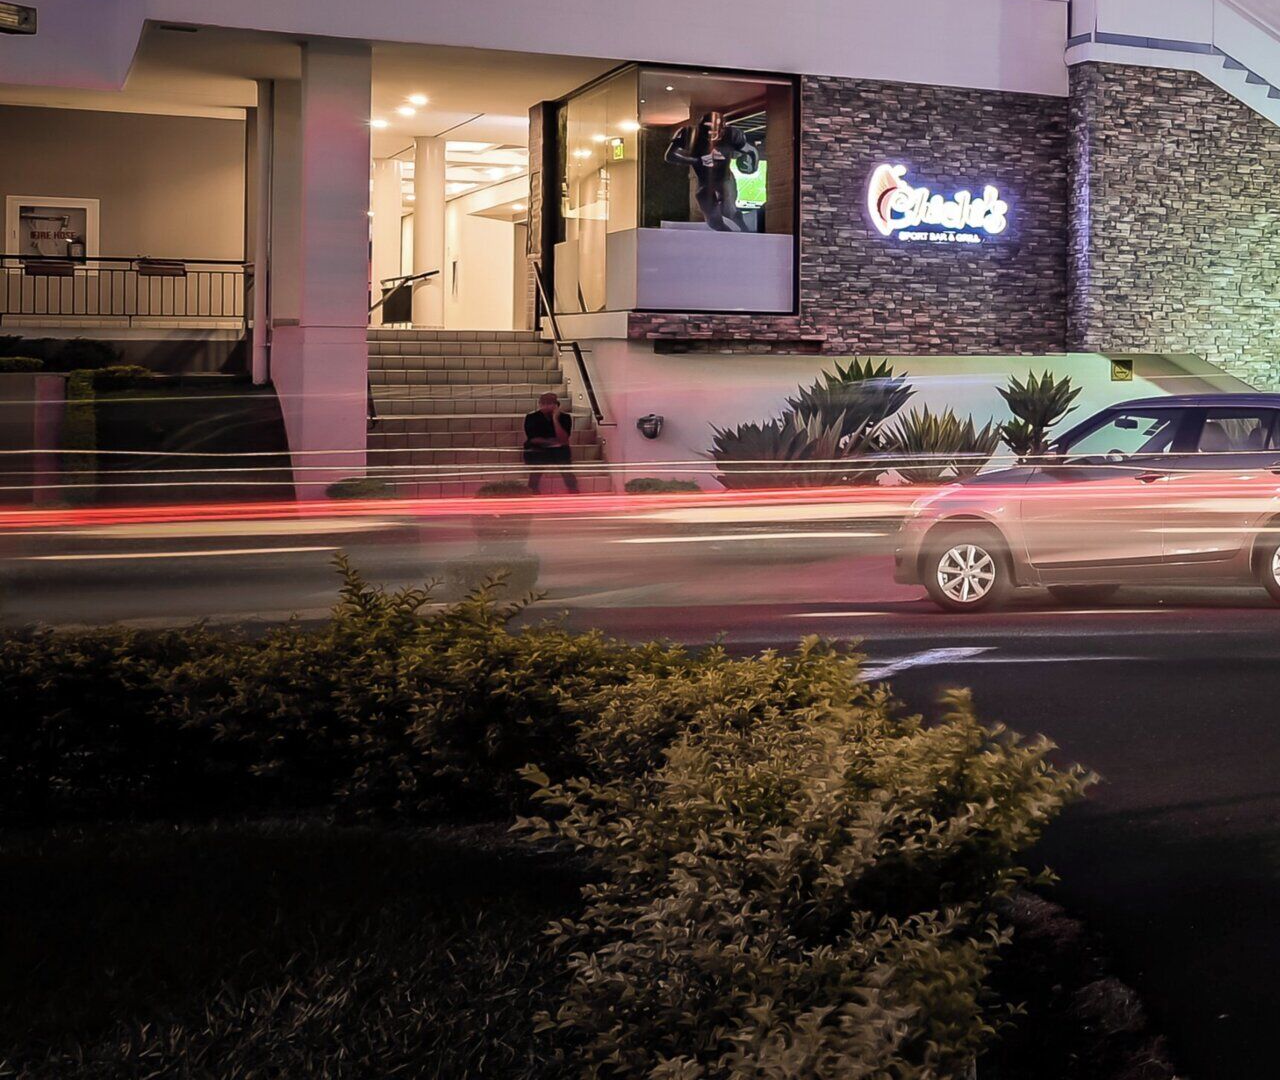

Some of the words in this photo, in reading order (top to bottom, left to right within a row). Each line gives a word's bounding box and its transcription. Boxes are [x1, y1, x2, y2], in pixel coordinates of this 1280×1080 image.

[30, 230, 52, 240] FIRE
[53, 231, 77, 240] HOSE
[898, 231, 928, 241] SPORT
[929, 232, 947, 241] BAR
[955, 233, 981, 243] GRILL
